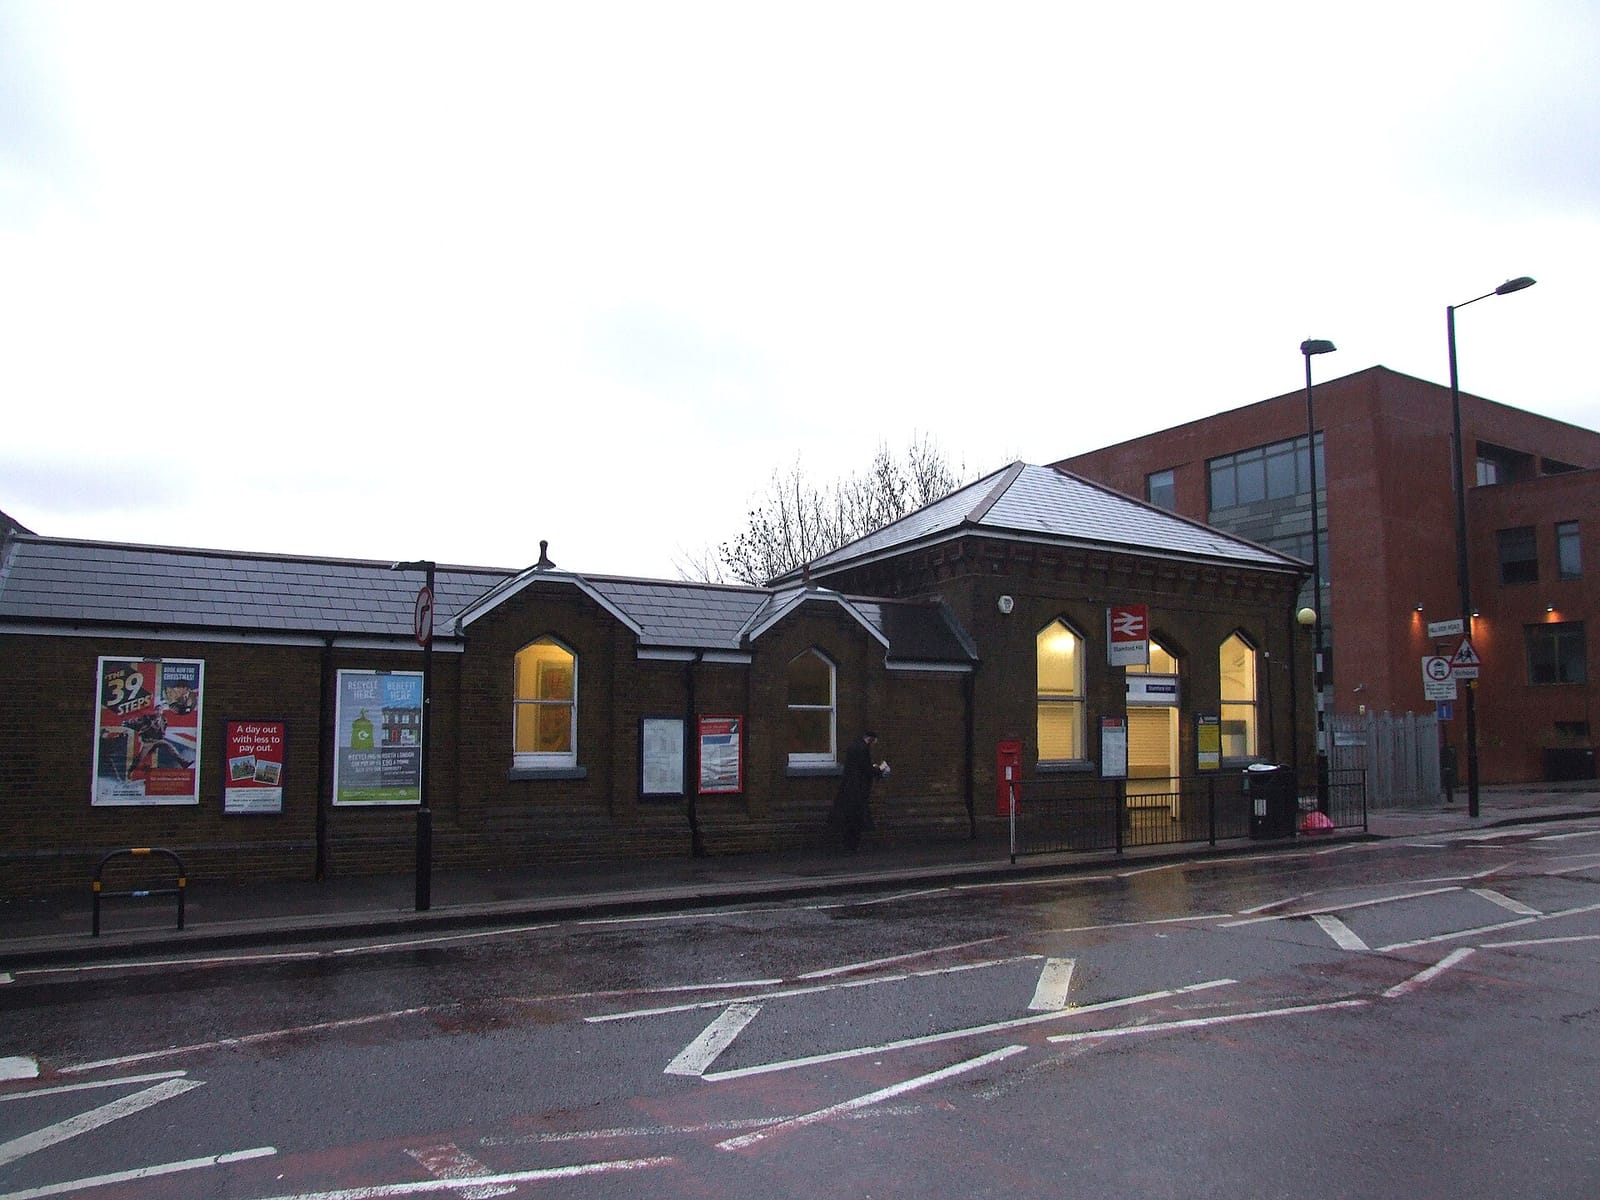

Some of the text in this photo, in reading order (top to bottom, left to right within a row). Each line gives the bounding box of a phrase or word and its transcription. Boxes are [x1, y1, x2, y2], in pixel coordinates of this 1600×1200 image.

[104, 669, 126, 680] THE
[107, 672, 144, 706] 39
[386, 681, 416, 690] BENEFIT
[353, 690, 376, 699] HERE
[391, 690, 412, 700] HERE
[117, 695, 152, 716] STEPS
[236, 725, 277, 735] A day out
[232, 735, 252, 743] with
[254, 735, 269, 743] less
[239, 745, 254, 754] pay
